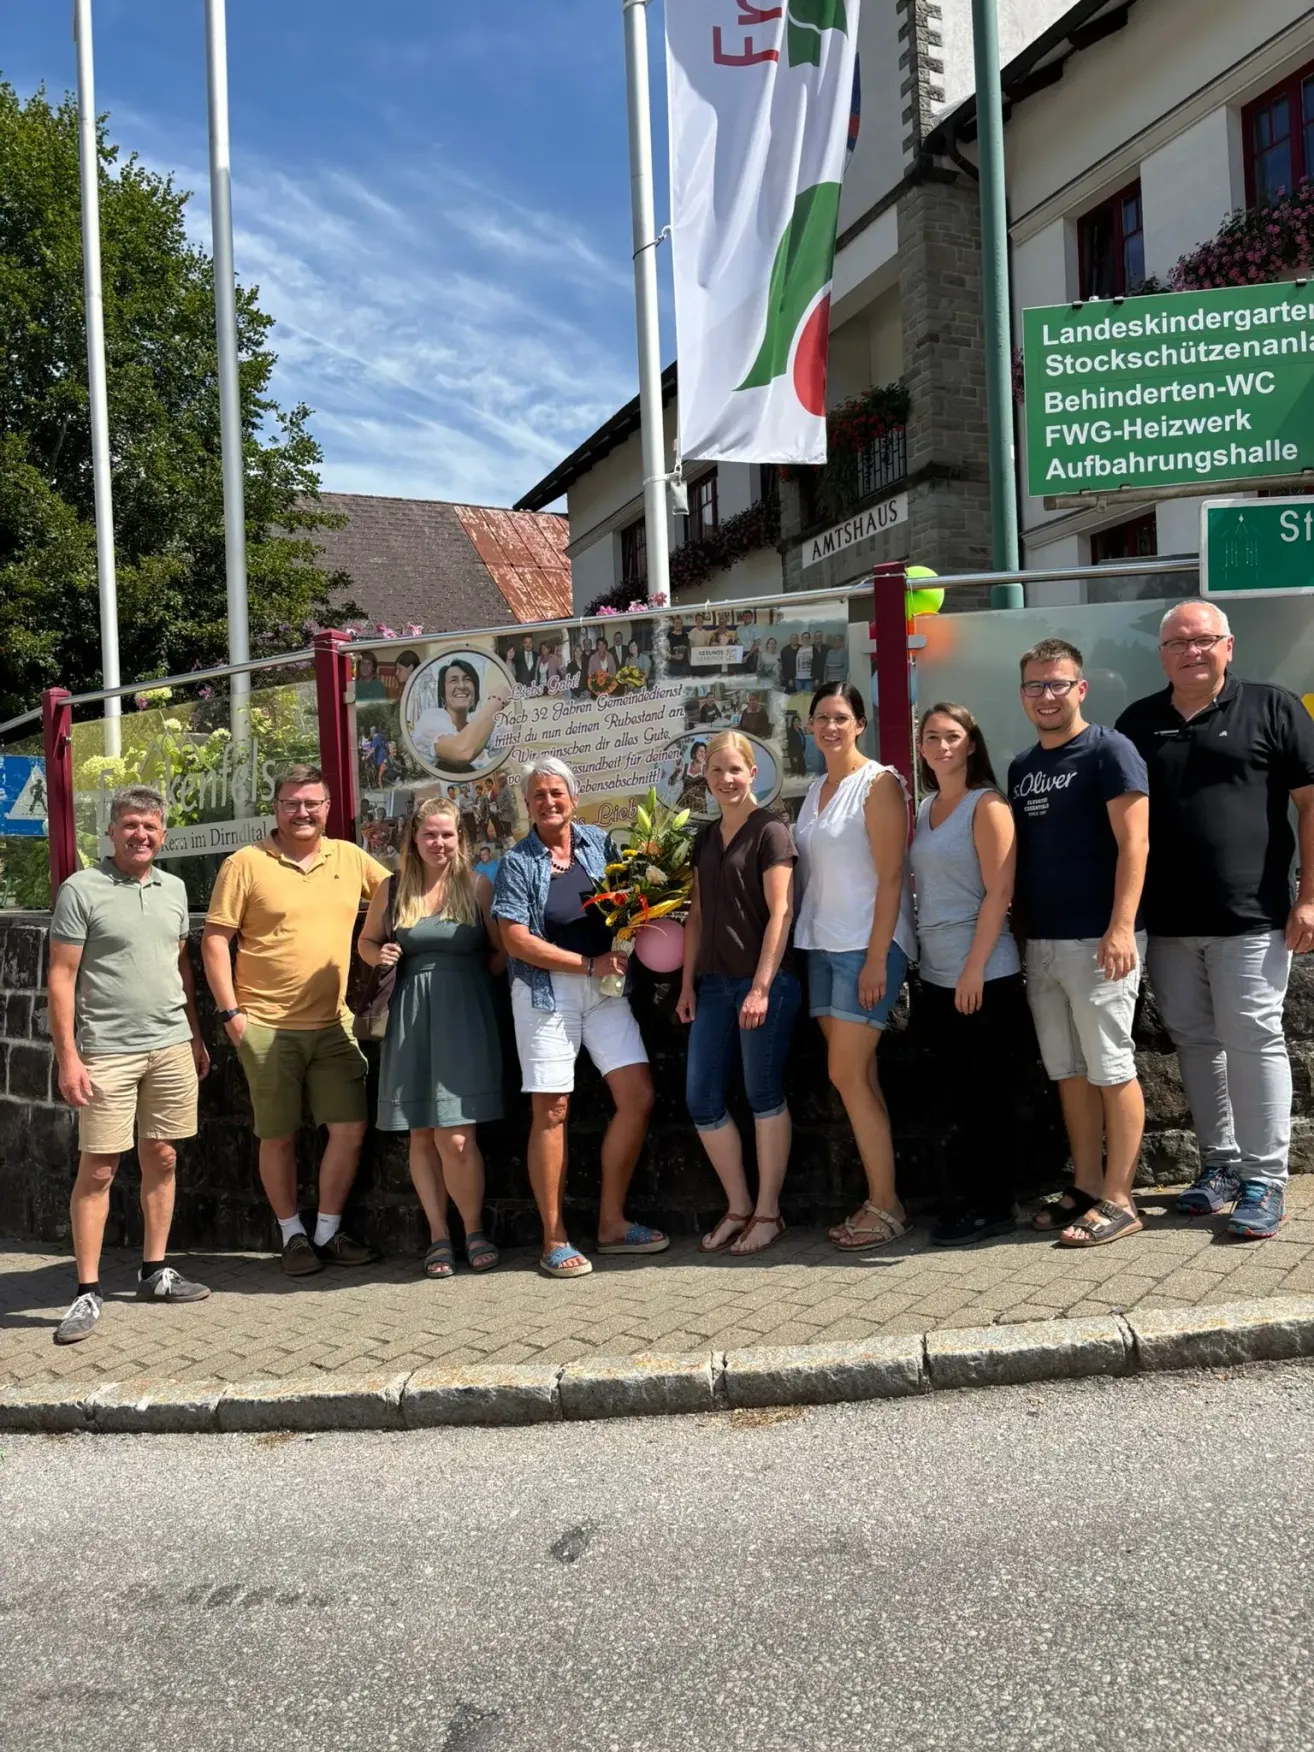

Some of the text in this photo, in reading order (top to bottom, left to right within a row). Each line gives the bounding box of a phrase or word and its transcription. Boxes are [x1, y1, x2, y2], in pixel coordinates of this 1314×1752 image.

[1045, 371, 1275, 413] Behinderten-WC
[1045, 409, 1251, 447] FWG-Heizwerk
[1045, 440, 1298, 480] Aufbahrungshalle
[812, 500, 898, 560] AMTSHAUS
[494, 684, 683, 727] Nach 32 Jahren Gemeindedienst
[508, 672, 581, 700] Liebe Gabi!
[495, 732, 521, 747] trittst
[525, 727, 537, 742] du
[542, 729, 561, 740] nun
[565, 721, 599, 735] deinen
[604, 705, 666, 729] Ruhestand
[511, 747, 537, 763] Wir
[595, 736, 611, 750] dir
[614, 732, 639, 747] alles
[644, 727, 671, 744] Gute,
[624, 752, 642, 770] für
[645, 748, 680, 764] deinen
[99, 737, 276, 824] Fkenfels
[592, 797, 639, 827] Lieb
[191, 832, 207, 849] im
[210, 821, 267, 846] Dirndltal
